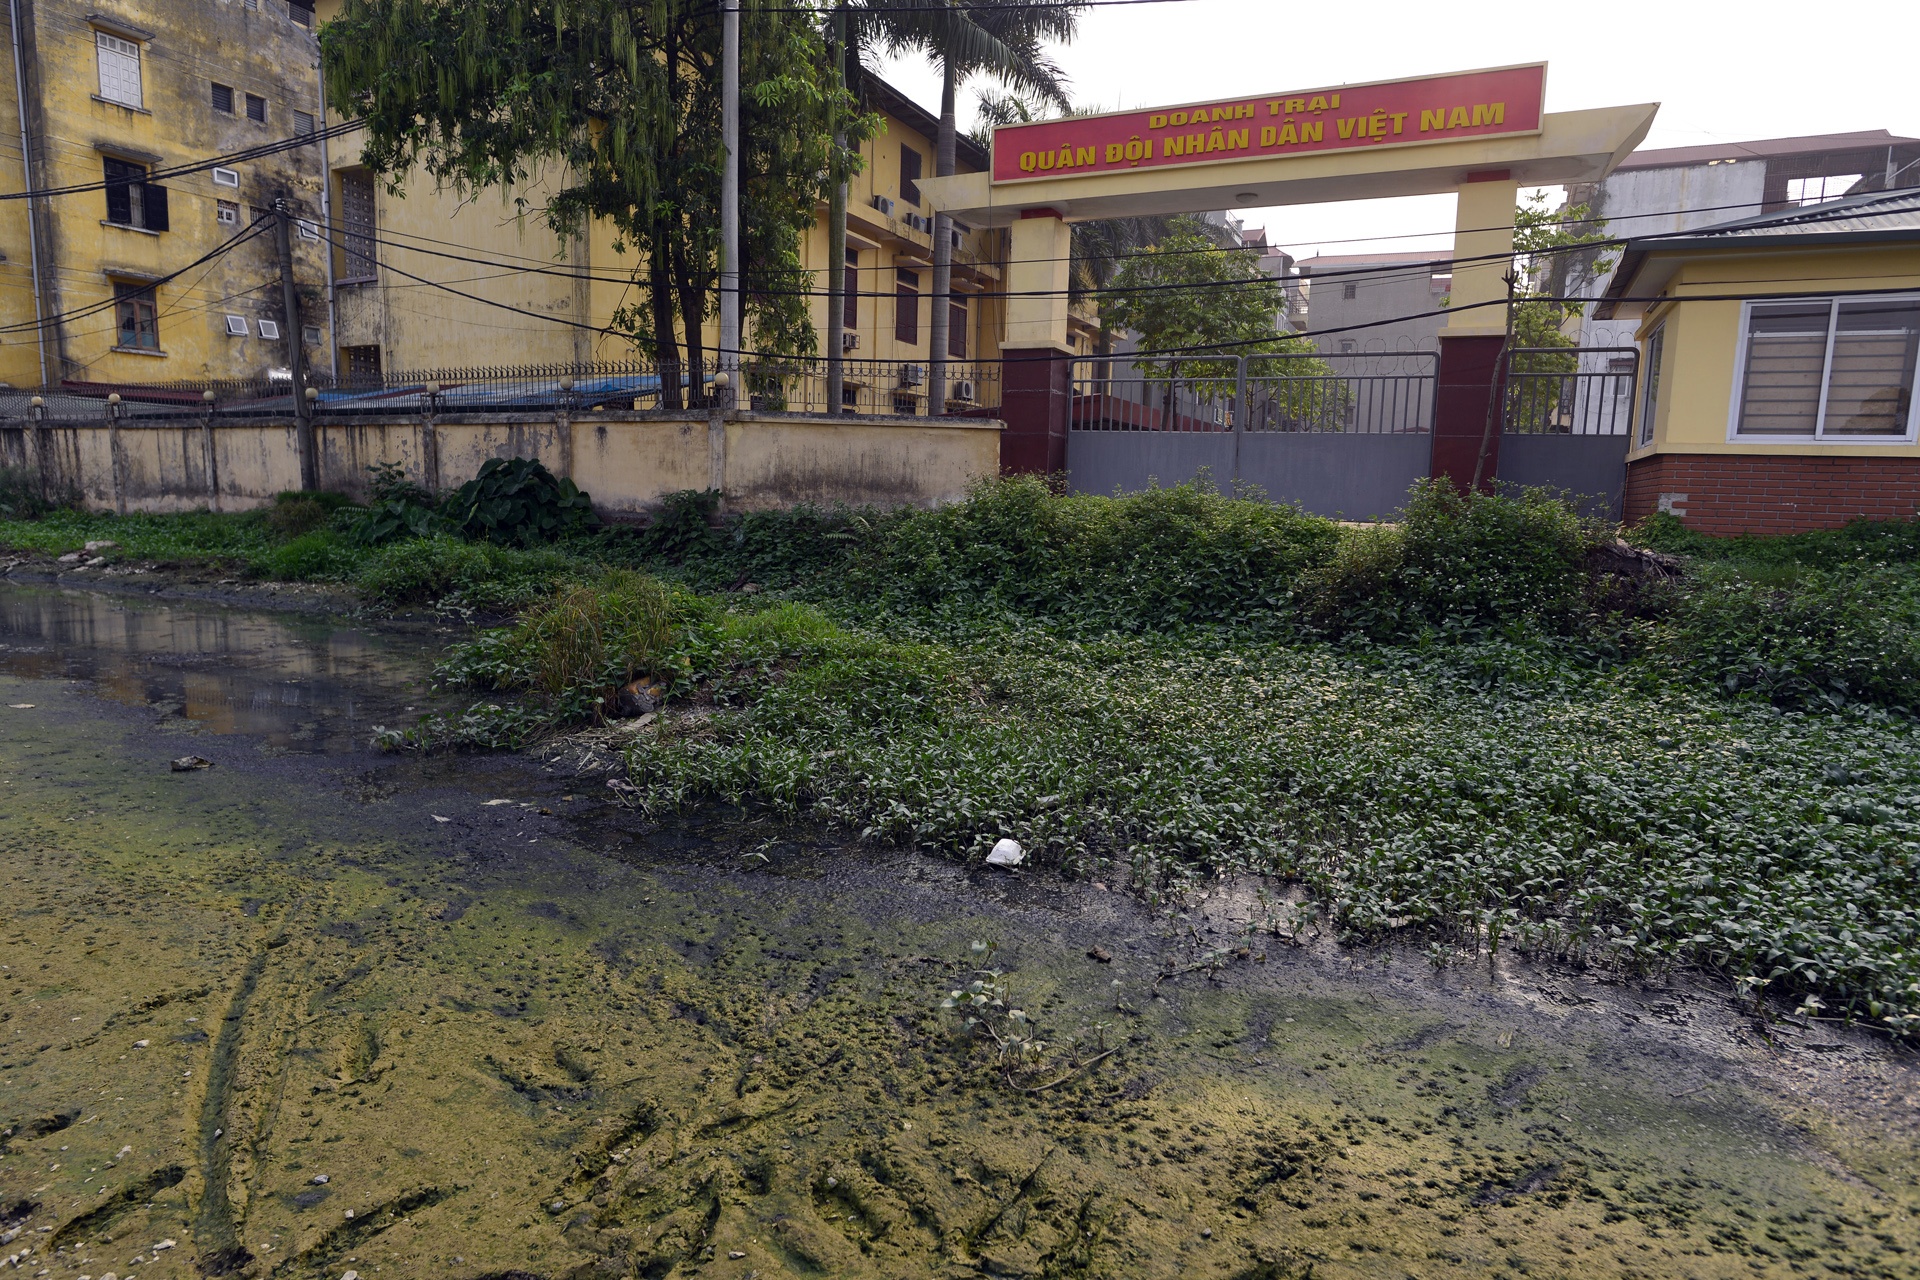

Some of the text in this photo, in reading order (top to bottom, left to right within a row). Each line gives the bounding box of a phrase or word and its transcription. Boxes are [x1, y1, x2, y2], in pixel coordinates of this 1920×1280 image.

[1149, 95, 1341, 128] DOANH TRẠI
[1019, 103, 1505, 172] QUÂN ĐỘI NHÂN DÂN VIỆT NAM
